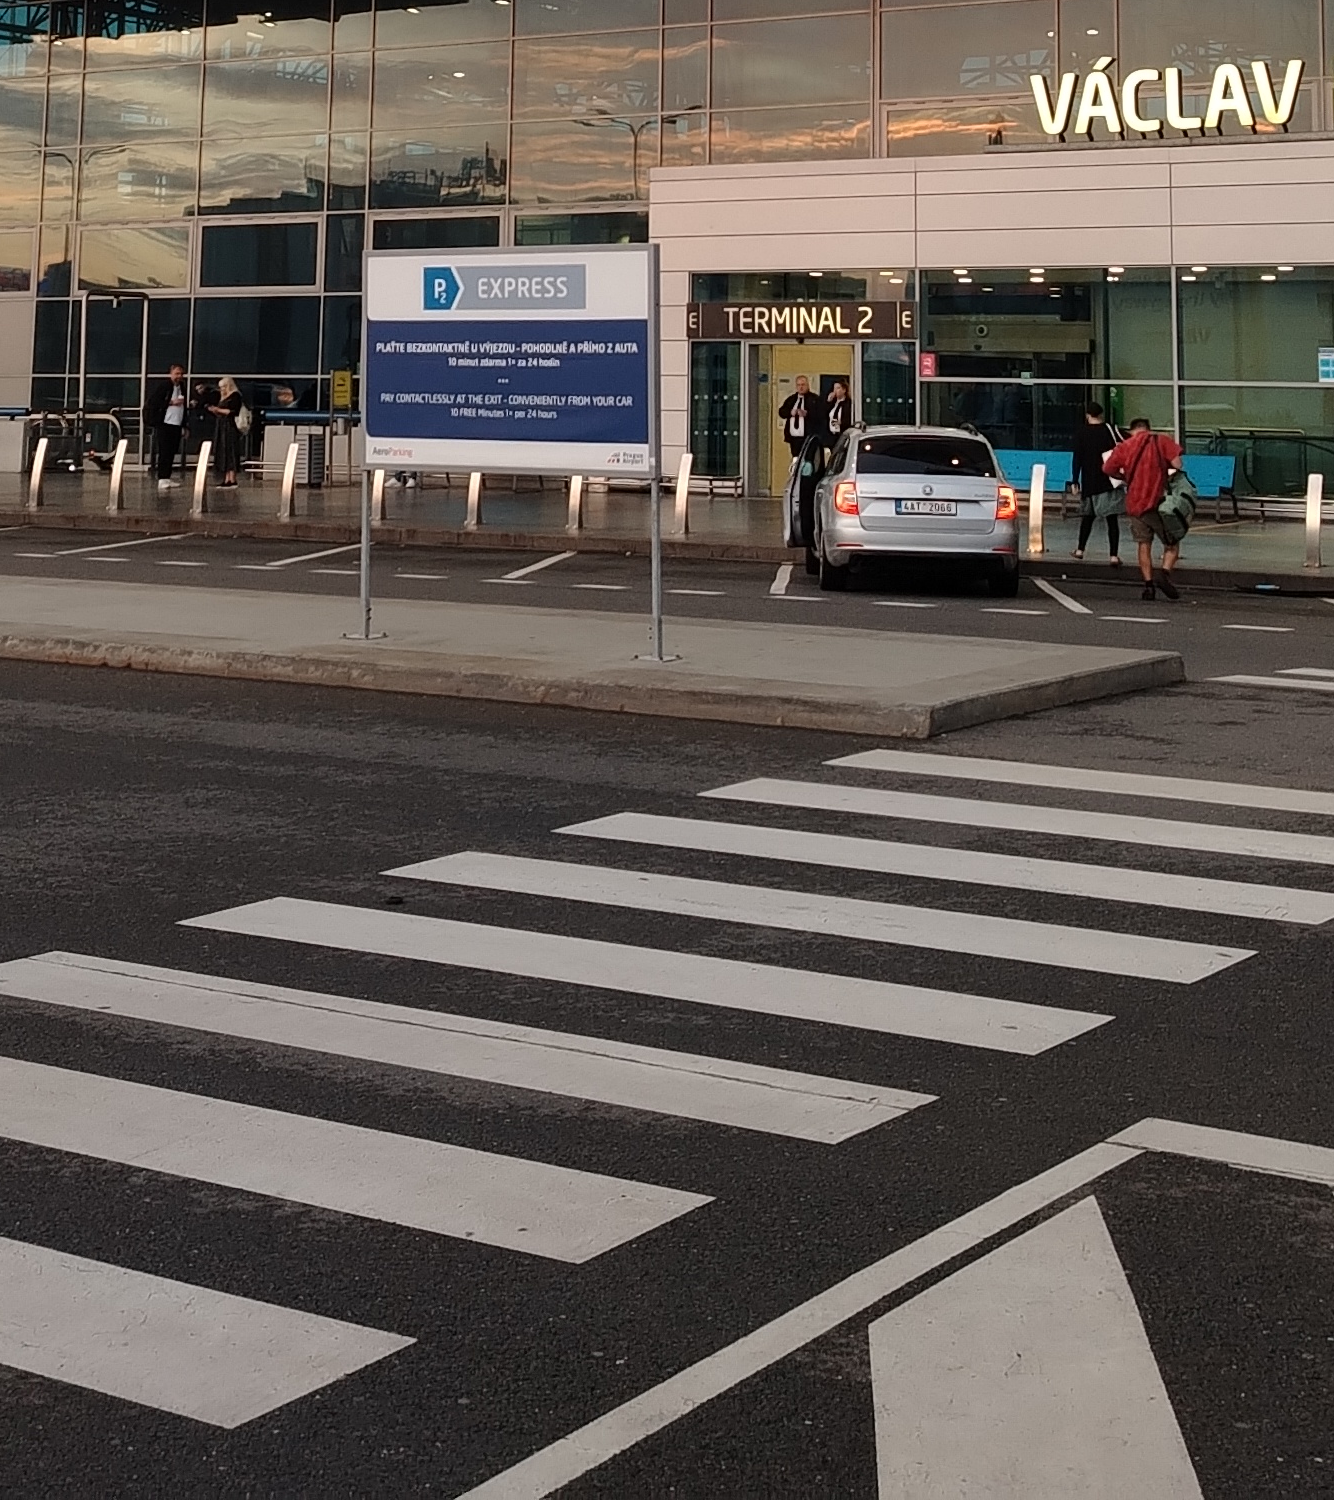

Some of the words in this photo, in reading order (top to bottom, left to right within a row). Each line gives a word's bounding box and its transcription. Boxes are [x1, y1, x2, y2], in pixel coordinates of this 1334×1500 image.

[1030, 56, 1304, 135] VÁCLAV
[478, 276, 568, 299] EXPRESS
[689, 312, 698, 329] E
[723, 306, 850, 334] TERMINAL
[857, 306, 873, 334] 2
[902, 310, 912, 329] E
[406, 340, 469, 353] BEZKONTAKTNĚ
[471, 342, 478, 353] U
[521, 340, 567, 354] POHODLNĚ
[569, 342, 576, 354] A
[607, 342, 613, 354] Z
[614, 342, 638, 354] AUTA
[448, 356, 457, 366] 10
[527, 357, 538, 367] 24
[380, 393, 394, 403] PAY
[395, 393, 455, 404] CONTACTLESSLY
[456, 394, 466, 404] AT
[467, 394, 483, 405] THE
[484, 394, 502, 405] EXIT
[508, 394, 566, 406] CONVENIENTLY
[567, 395, 591, 406] FROM
[592, 395, 614, 406] YOUR
[615, 395, 633, 407] CAR
[450, 407, 459, 417] 10
[460, 407, 476, 418] FREE
[527, 408, 537, 419] 24
[538, 408, 558, 419] hours
